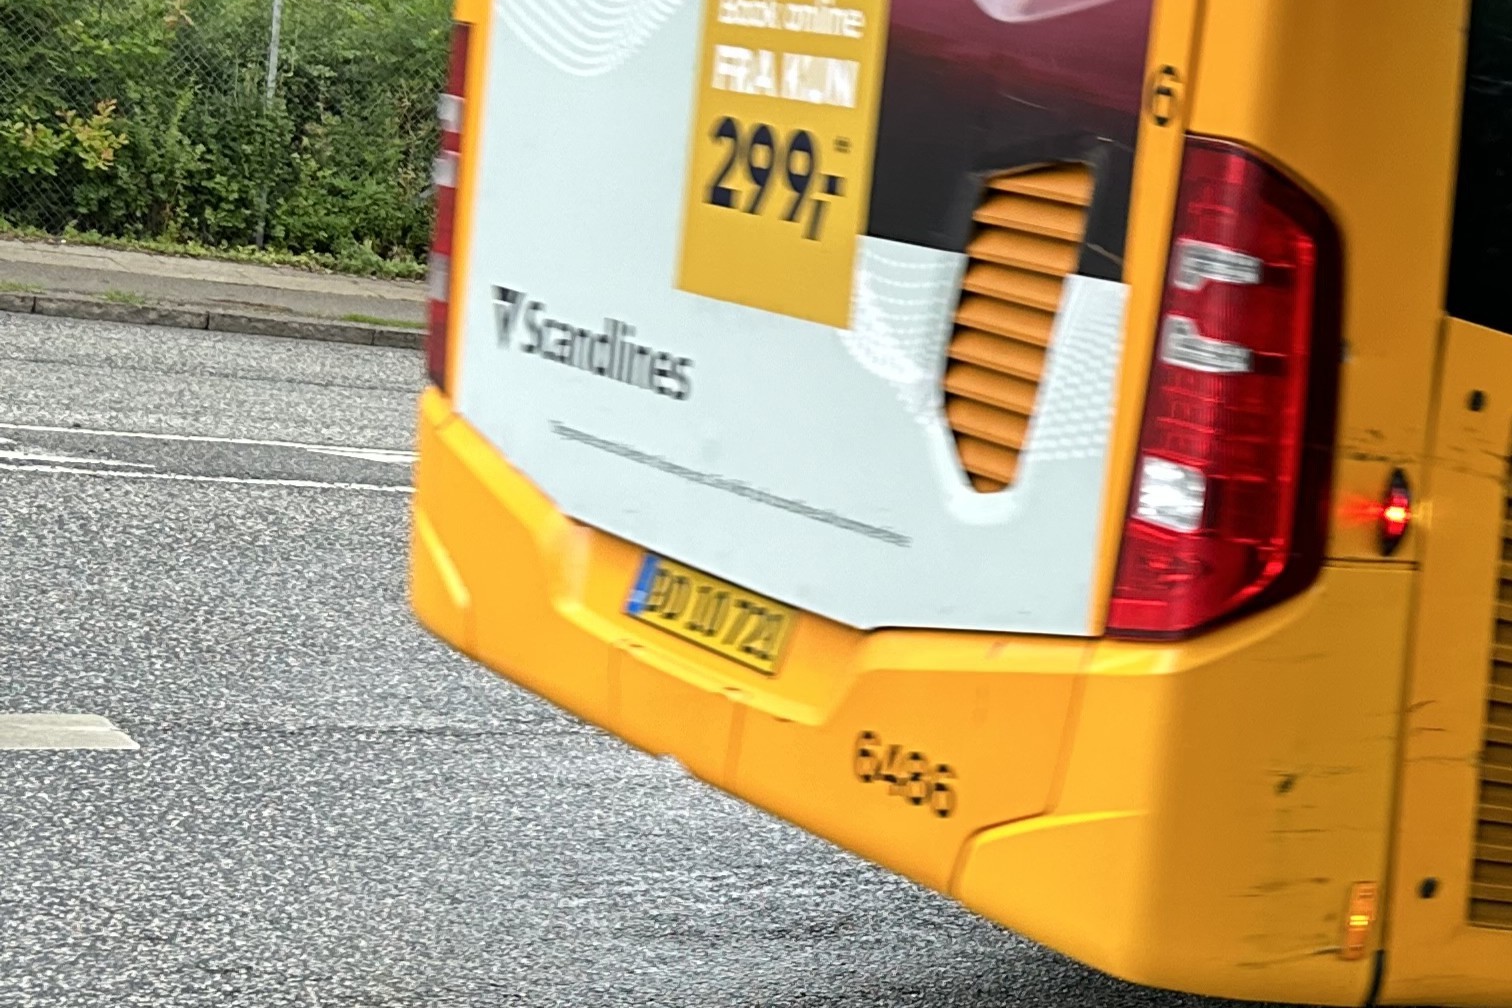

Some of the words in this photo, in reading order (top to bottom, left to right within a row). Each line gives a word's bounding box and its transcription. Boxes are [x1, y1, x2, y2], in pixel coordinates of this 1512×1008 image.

[711, 44, 779, 98] FRA
[779, 50, 861, 109] KUN
[1144, 63, 1182, 127] 6
[519, 300, 695, 401] Scandlines
[853, 730, 959, 819] 6486
